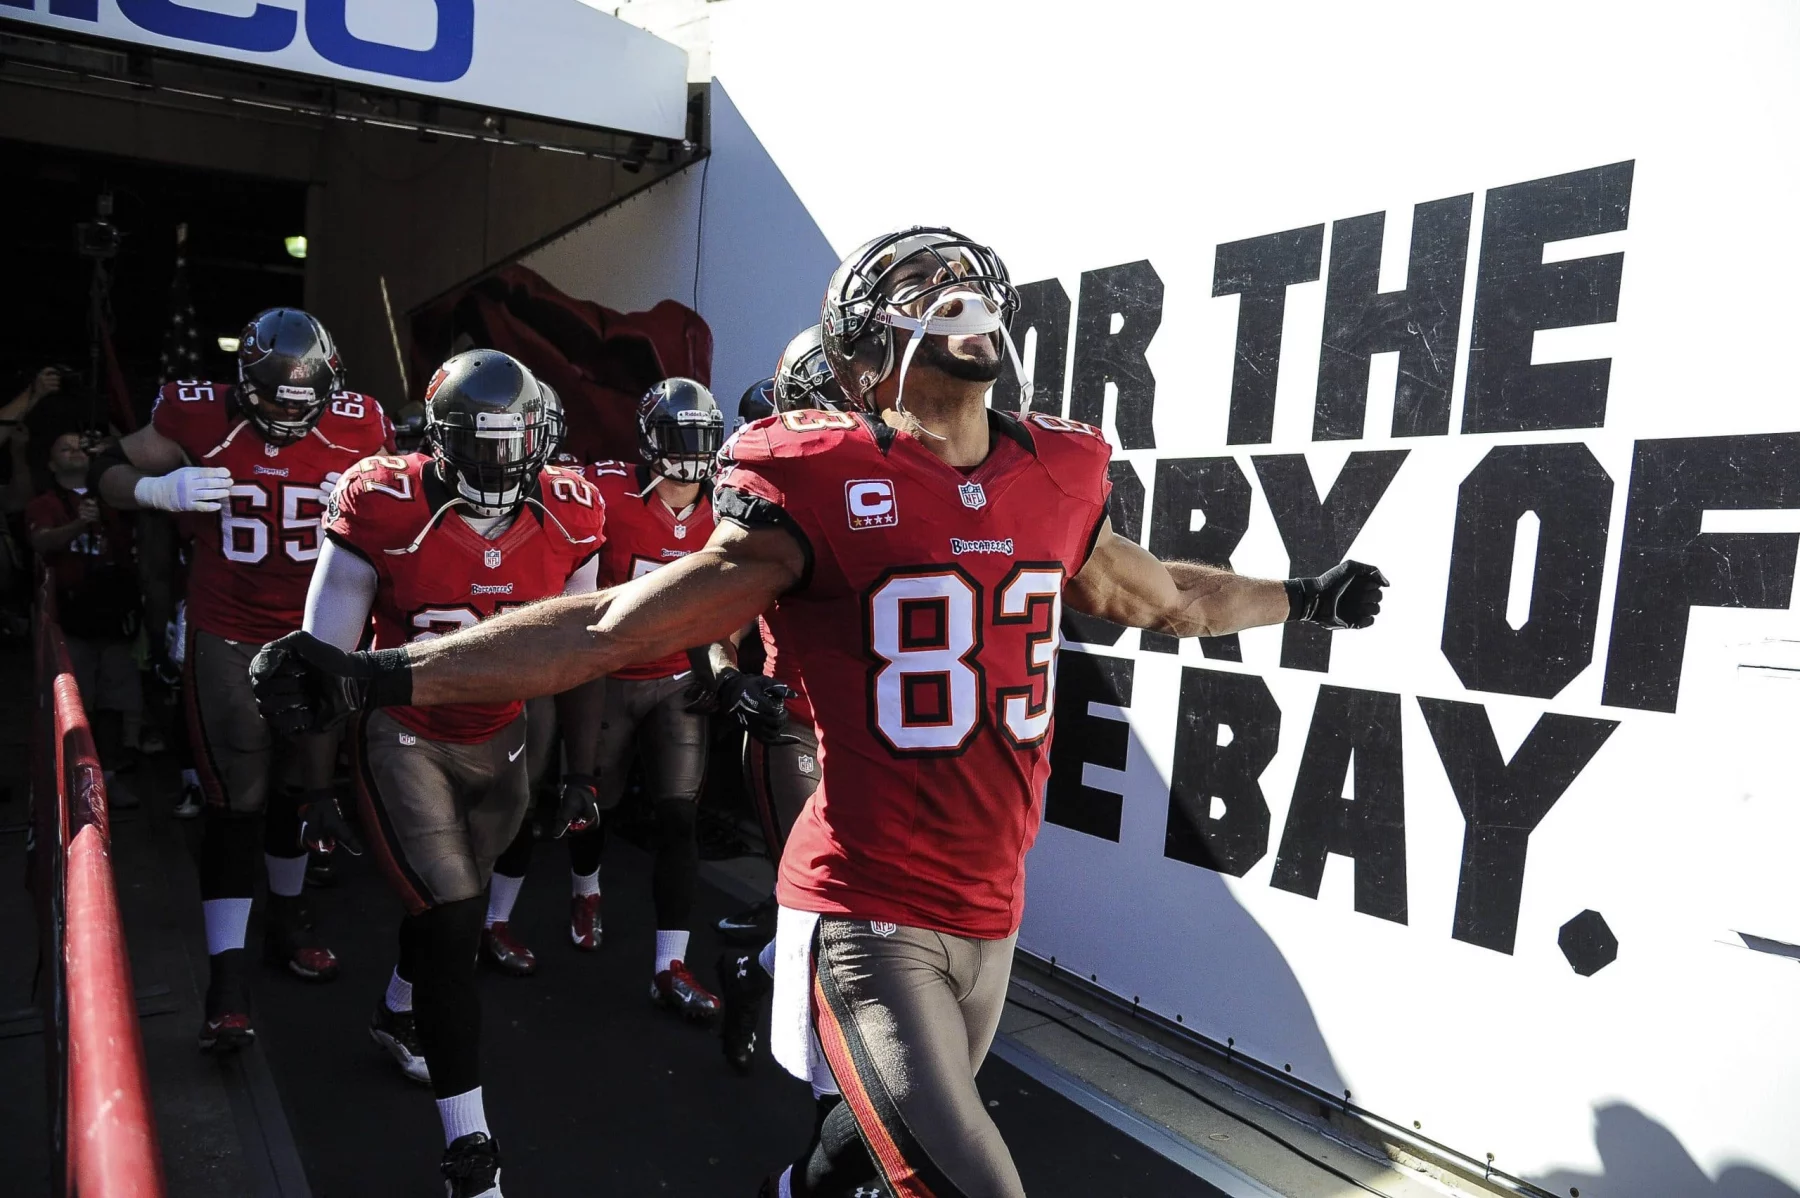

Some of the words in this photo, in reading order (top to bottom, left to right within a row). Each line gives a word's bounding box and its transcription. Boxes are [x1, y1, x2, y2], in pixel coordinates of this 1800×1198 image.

[863, 308, 893, 324] Rdell.
[1211, 159, 1635, 445] THE
[221, 484, 325, 564] 65
[849, 482, 893, 516] C
[1440, 431, 1800, 714] OF
[866, 564, 1064, 754] 83
[1164, 666, 1622, 977] BAY.
